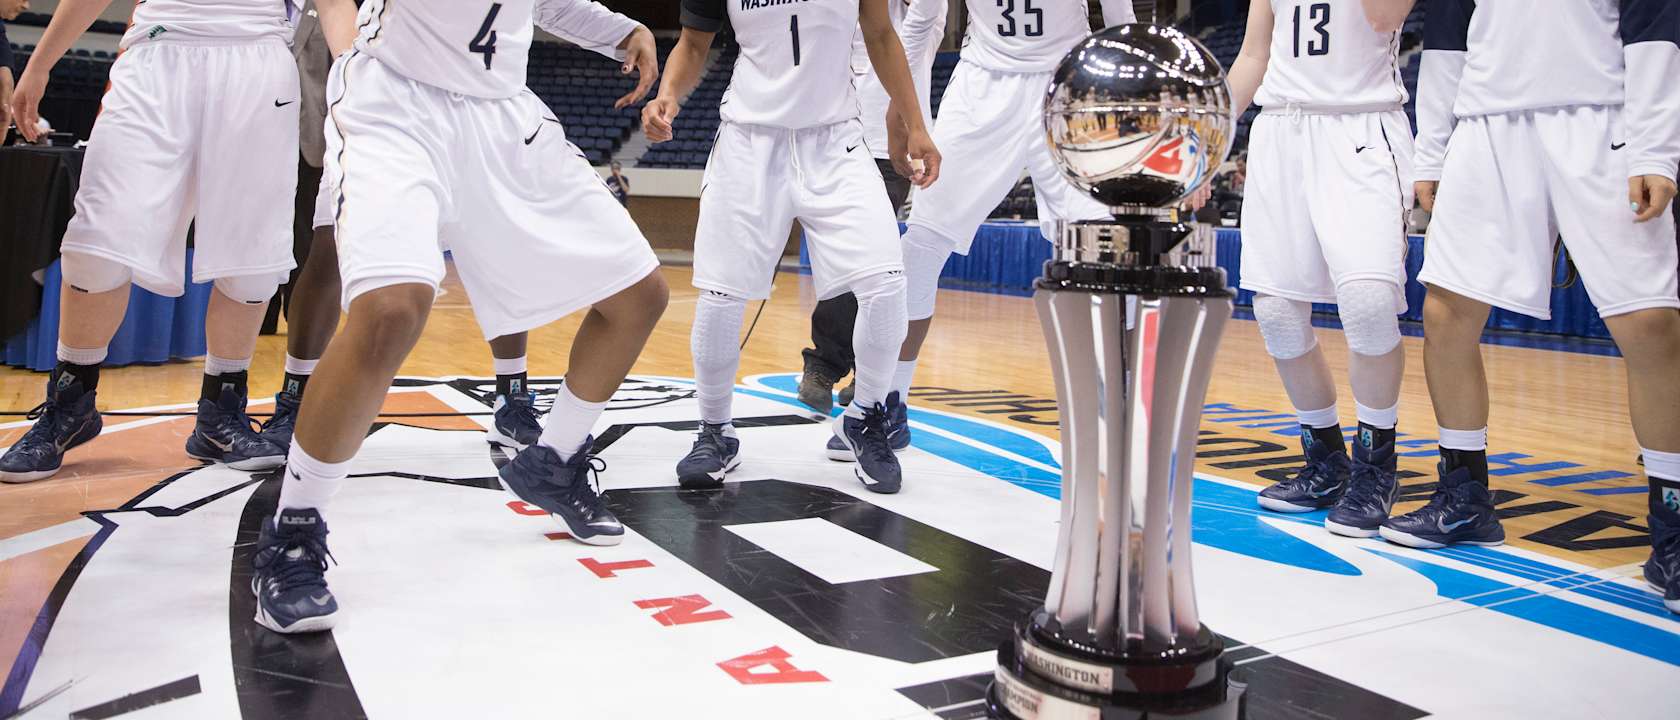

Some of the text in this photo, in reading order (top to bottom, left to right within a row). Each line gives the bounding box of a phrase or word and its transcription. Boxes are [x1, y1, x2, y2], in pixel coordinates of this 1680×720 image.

[469, 2, 502, 70] 4
[790, 14, 800, 66] 1
[996, 0, 1043, 37] 35
[1292, 3, 1330, 58] 13
